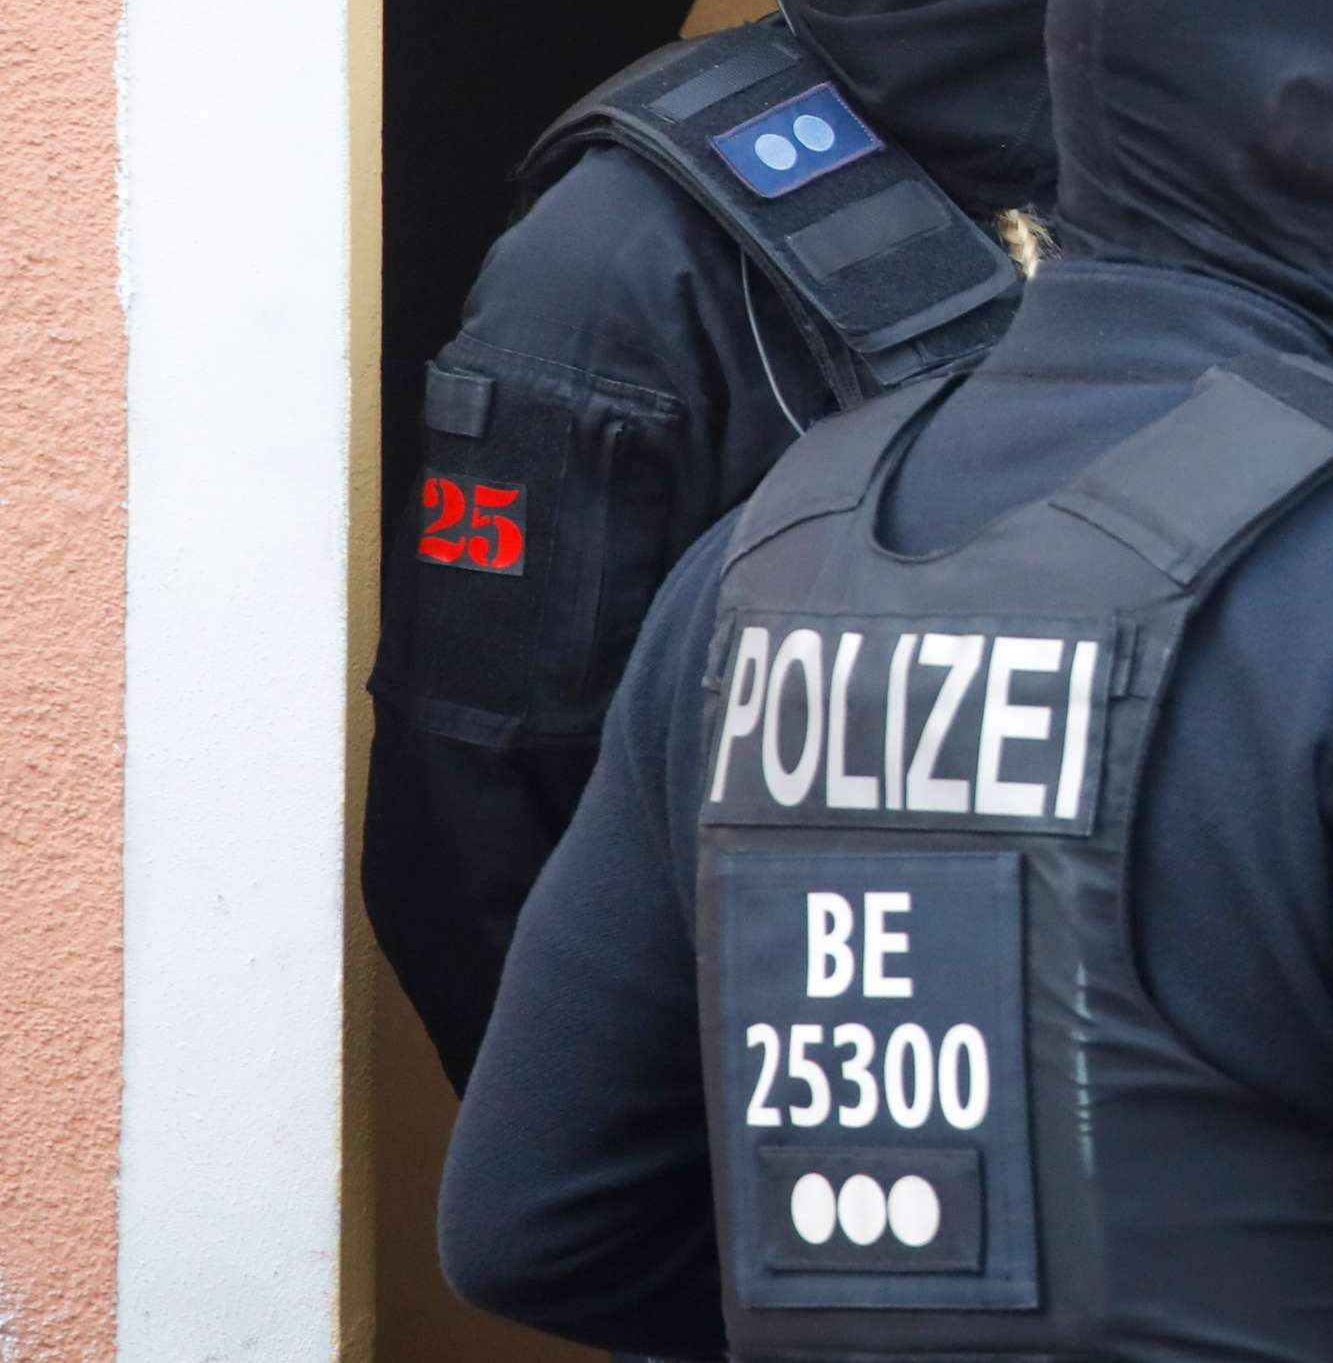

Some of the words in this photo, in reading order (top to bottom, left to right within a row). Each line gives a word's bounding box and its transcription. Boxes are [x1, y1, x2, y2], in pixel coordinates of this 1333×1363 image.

[418, 477, 525, 569] 25
[710, 626, 1098, 820] POLIZEI
[805, 892, 914, 999] BE
[744, 1022, 991, 1130] 25300
